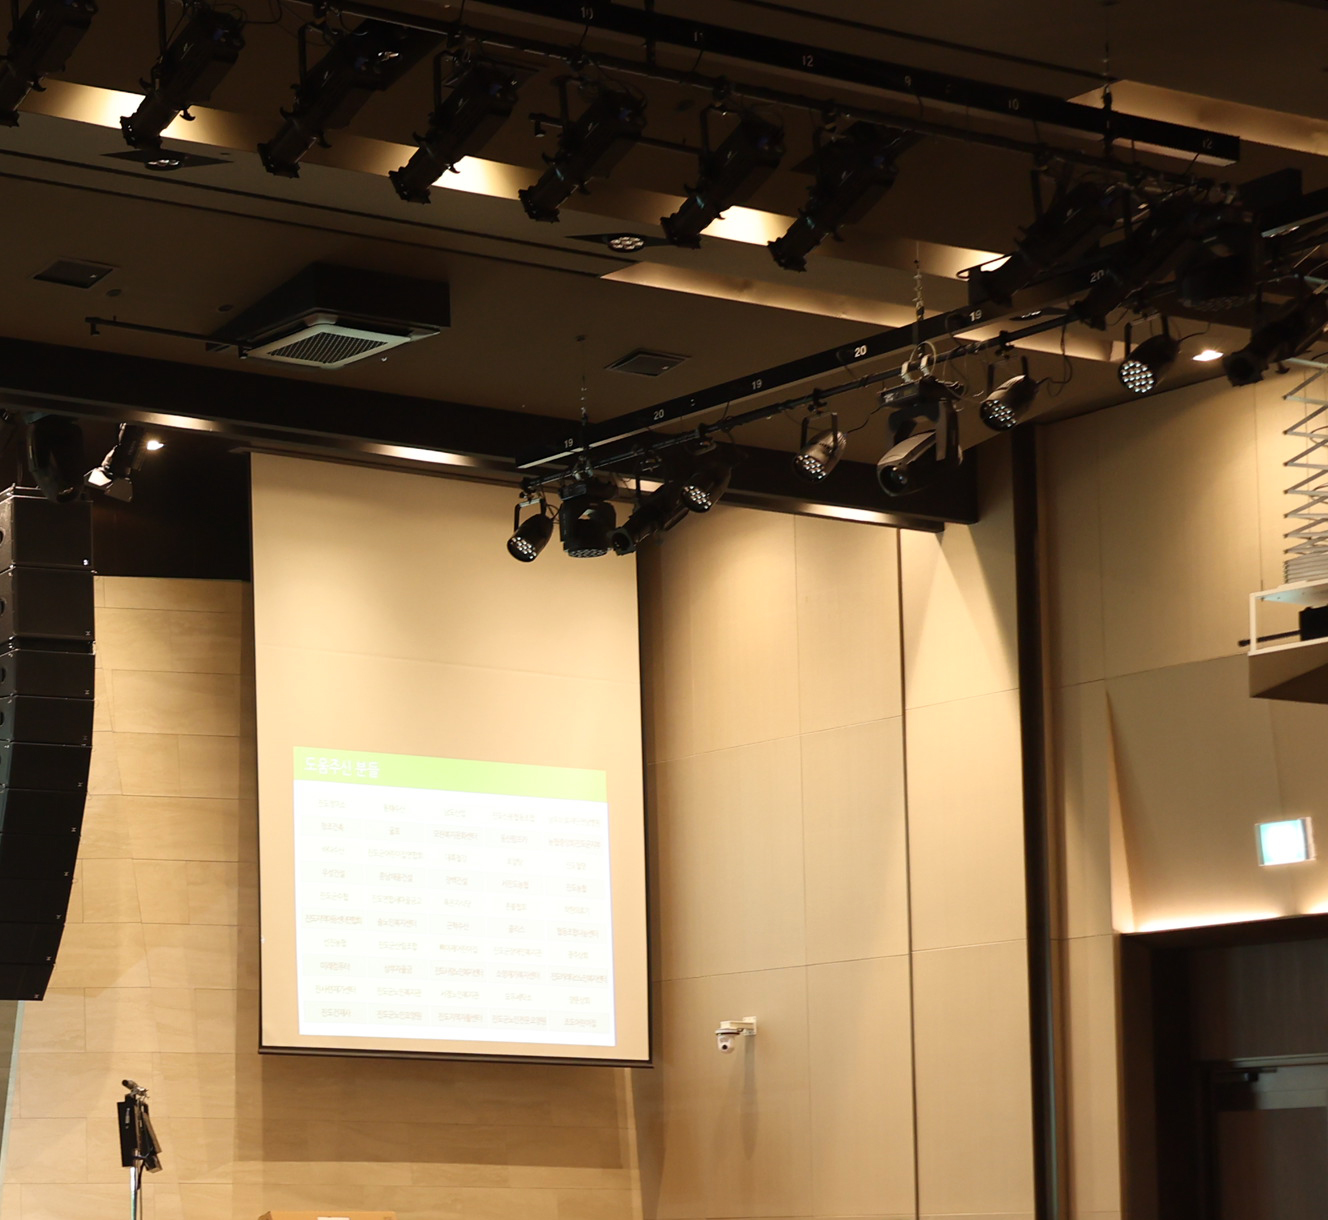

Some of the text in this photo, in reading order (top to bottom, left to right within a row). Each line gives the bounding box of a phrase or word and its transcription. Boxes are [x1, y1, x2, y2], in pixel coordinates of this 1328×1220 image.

[969, 309, 982, 322] 19
[854, 344, 867, 358] 20
[751, 379, 763, 391] 19
[653, 408, 665, 420] 20
[564, 437, 574, 449] 19
[304, 756, 380, 780] 도움주신 분들
